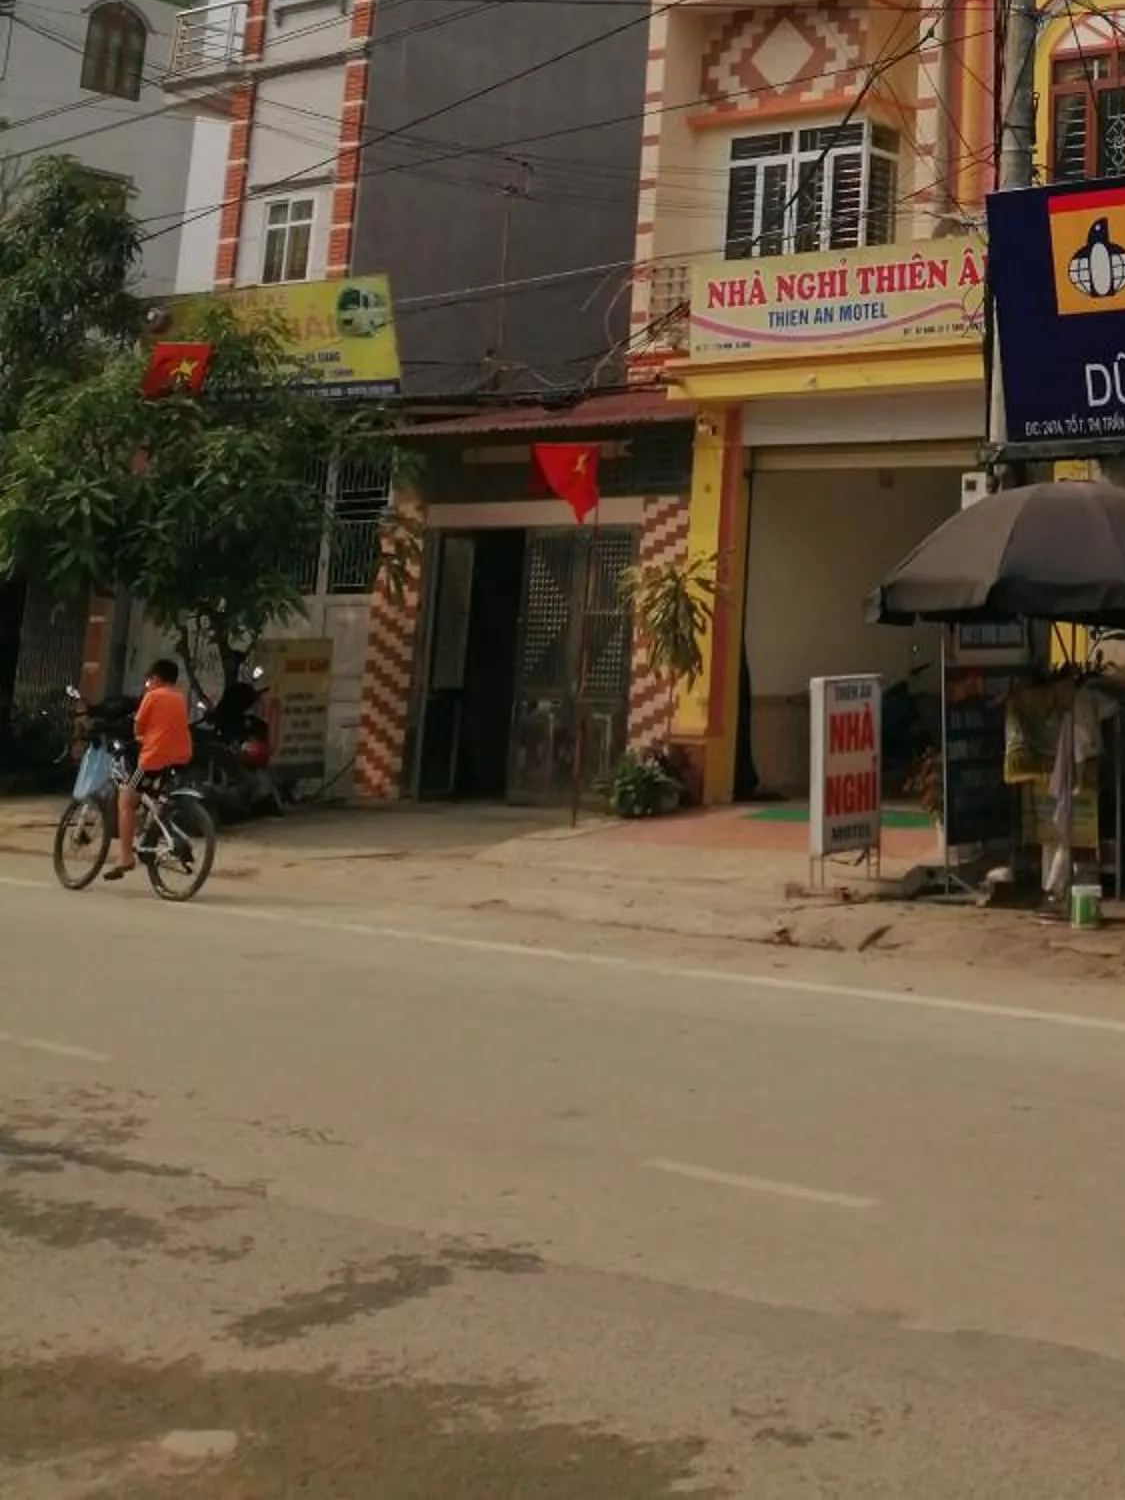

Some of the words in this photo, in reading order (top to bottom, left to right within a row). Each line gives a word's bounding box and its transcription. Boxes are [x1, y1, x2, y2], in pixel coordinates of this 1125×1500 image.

[706, 269, 768, 309] NHÀ
[776, 258, 849, 301] NGHỈ
[855, 253, 949, 295] THIÊN
[768, 310, 809, 329] THIEN
[813, 307, 834, 324] AN
[839, 301, 888, 321] MOTEL
[829, 703, 875, 754] NHÀ
[825, 755, 878, 817] NGHỈ
